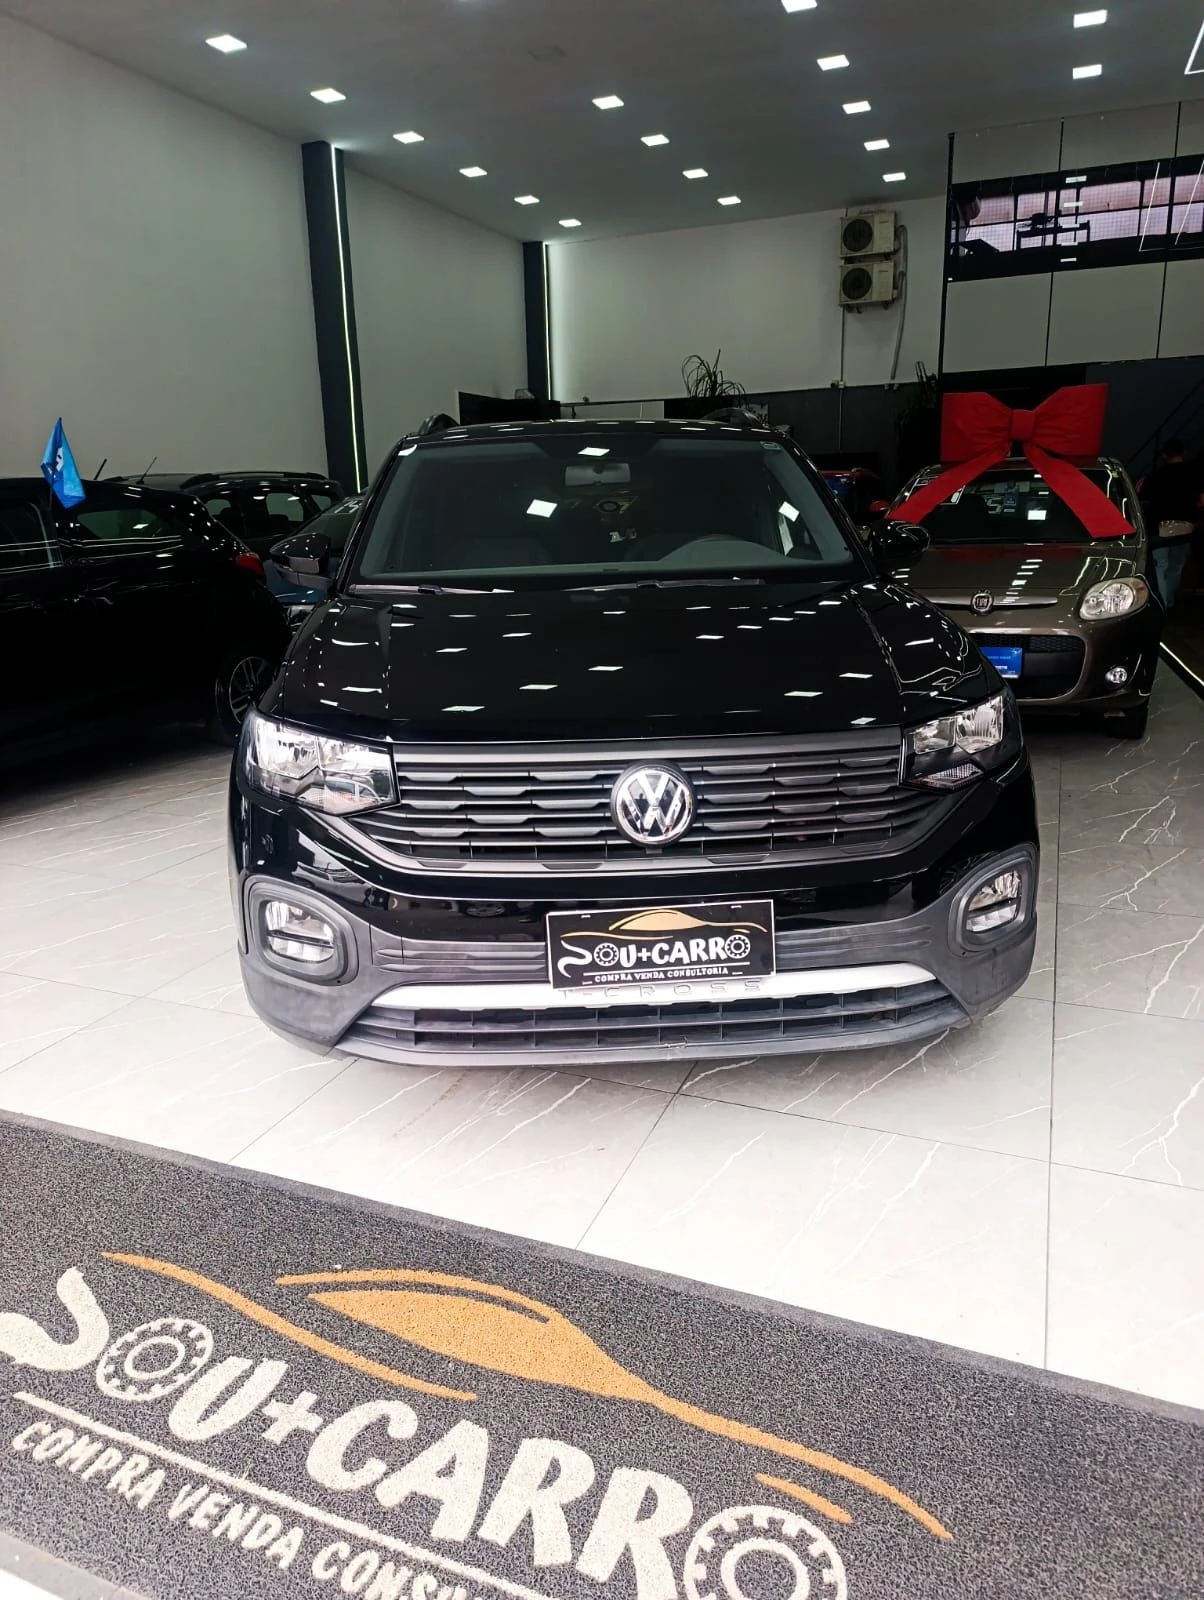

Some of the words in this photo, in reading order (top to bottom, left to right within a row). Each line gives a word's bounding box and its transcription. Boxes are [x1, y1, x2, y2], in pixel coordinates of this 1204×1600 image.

[557, 934, 751, 978] SOU+CARRO
[594, 972, 633, 983] COMPRA
[634, 971, 665, 980] VENDA
[667, 966, 729, 978] CONSULTORIA
[12, 1420, 166, 1510] COMPRA
[168, 1483, 304, 1569] VENDA
